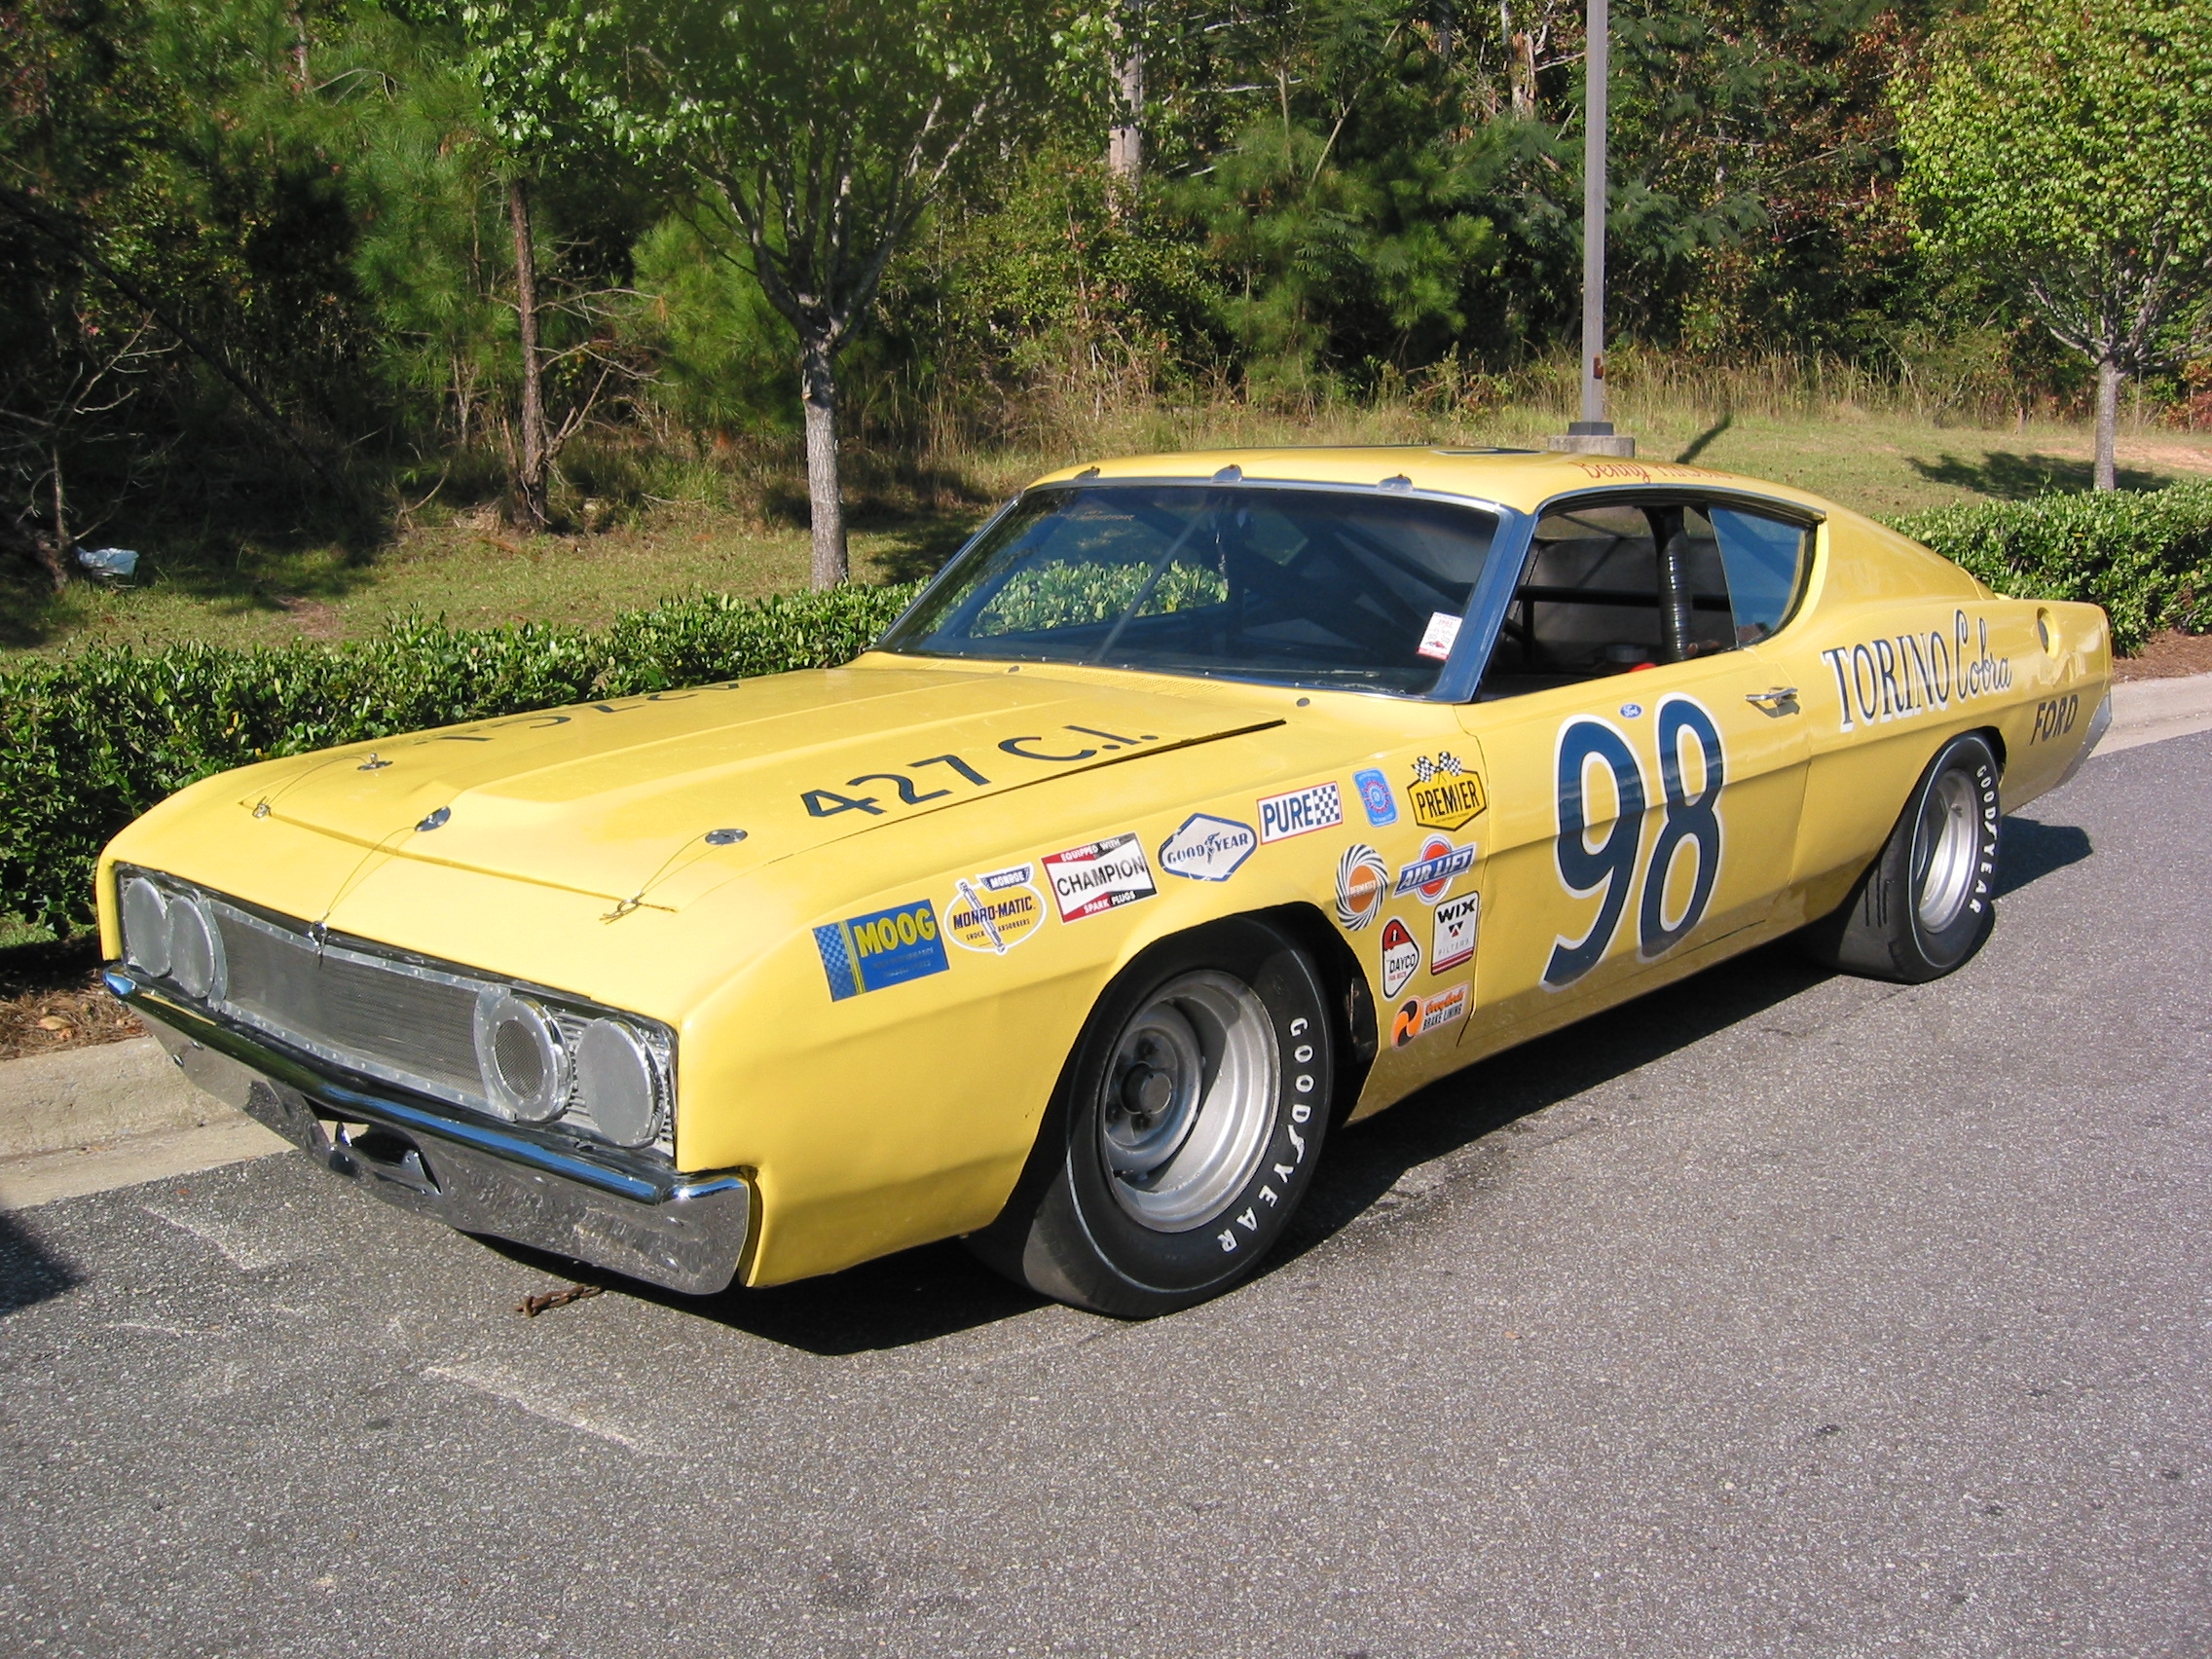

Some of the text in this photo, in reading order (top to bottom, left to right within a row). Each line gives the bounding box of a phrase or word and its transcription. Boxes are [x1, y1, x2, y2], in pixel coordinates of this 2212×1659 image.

[1820, 608, 2013, 733] TORINO Cobra
[2029, 693, 2080, 746] FORD
[800, 725, 1160, 818] 427 C.I.
[1262, 793, 1314, 837] PURE
[1415, 780, 1481, 821] PREMIER
[1060, 838, 1122, 863] EQUIPPED WITH
[1538, 691, 1728, 994] 98
[989, 870, 1025, 888] MONROE
[1056, 855, 1146, 897] CHAMPION
[1399, 850, 1472, 890] AIR LIFT
[1083, 890, 1136, 914] SPARK PLUGS
[1437, 898, 1476, 923] WIX
[853, 907, 937, 958] MOOG
[1437, 938, 1470, 955] FILTERS
[1388, 953, 1417, 974] DAYCO
[1422, 1011, 1442, 1031] BRAKE
